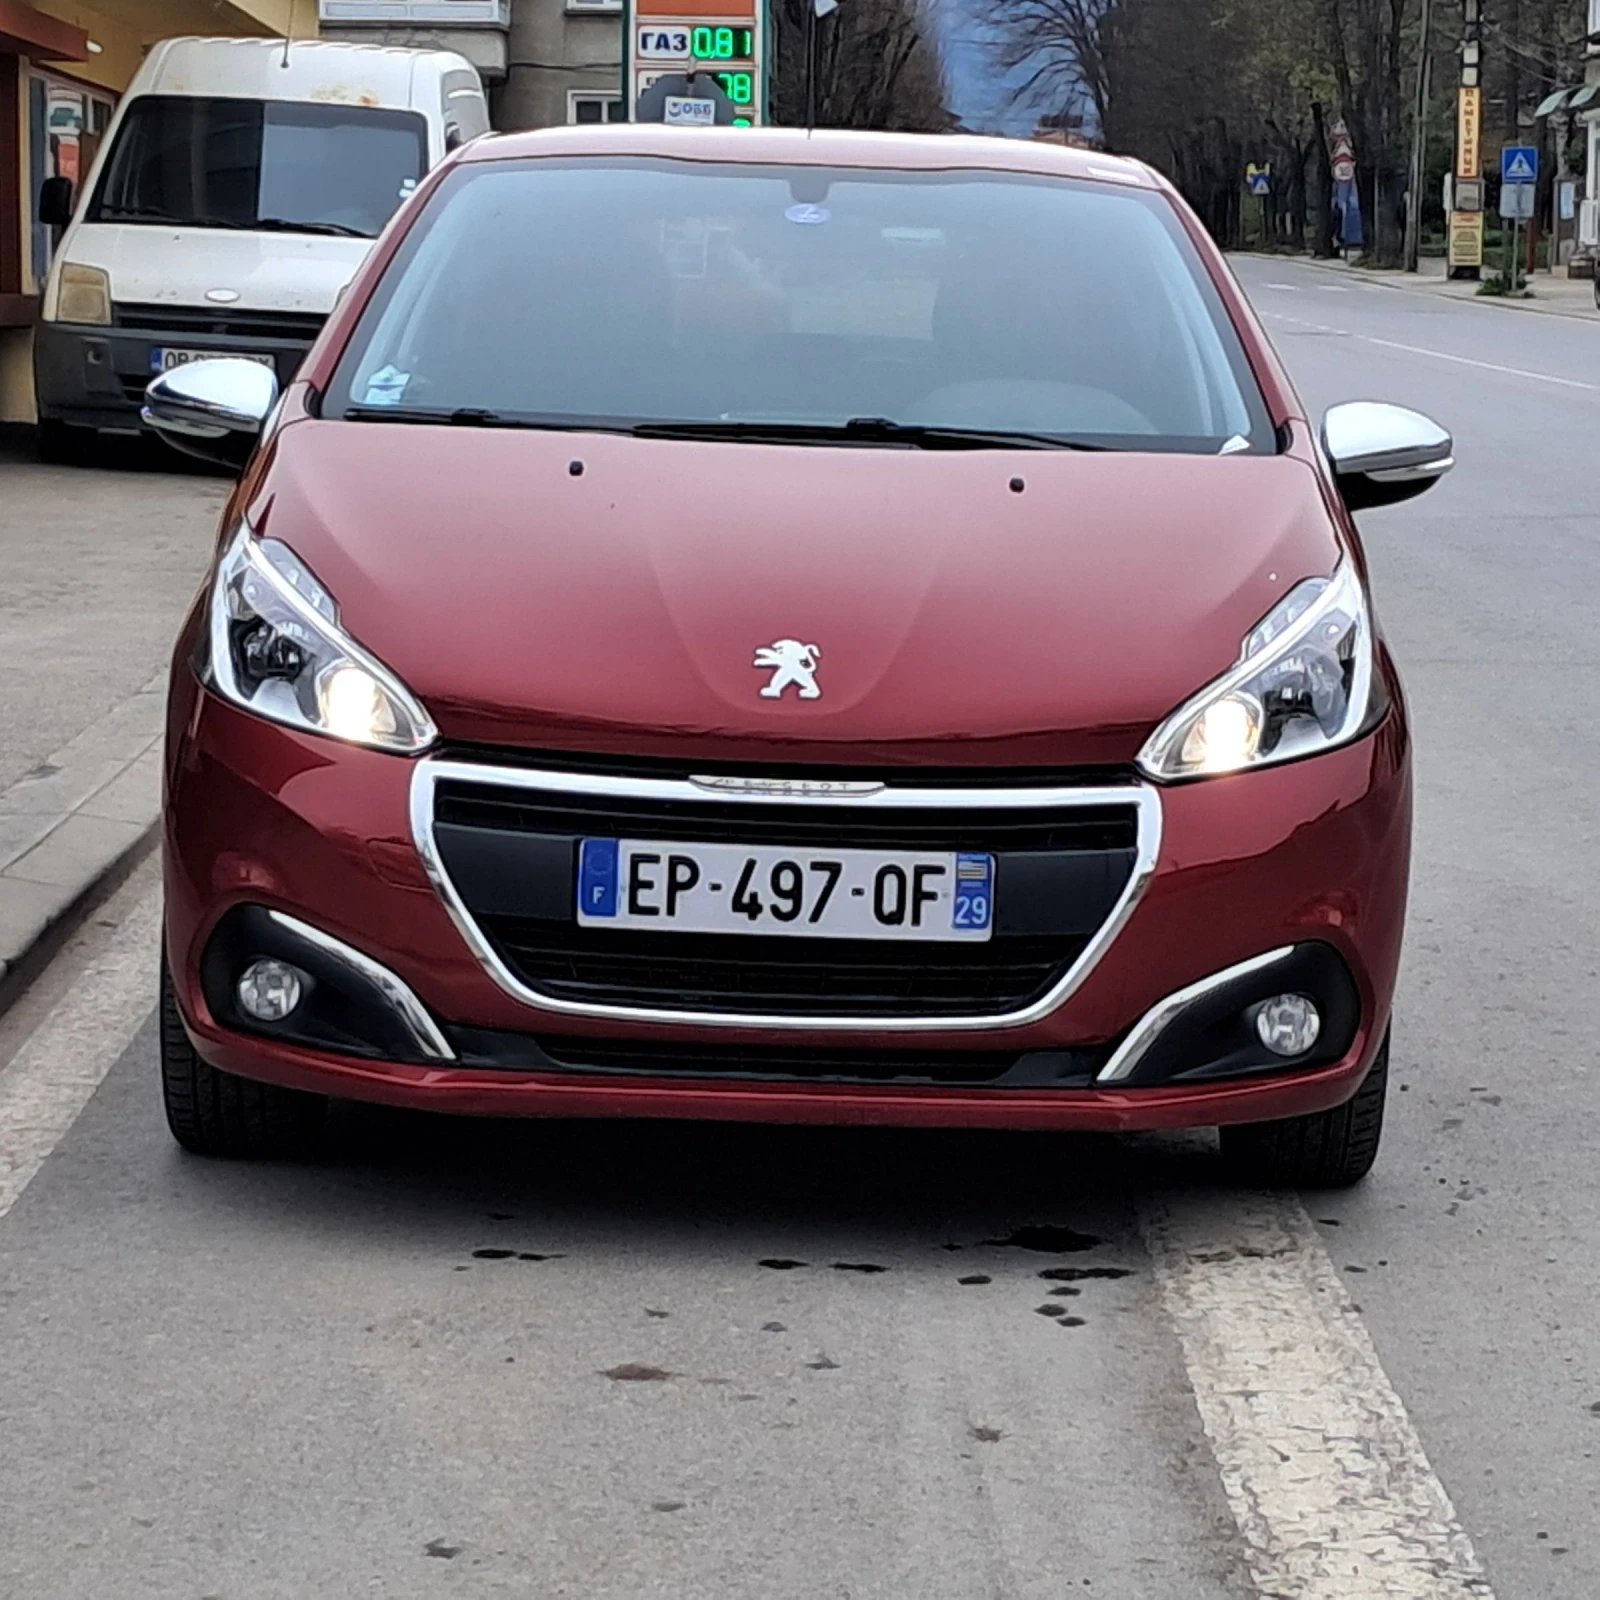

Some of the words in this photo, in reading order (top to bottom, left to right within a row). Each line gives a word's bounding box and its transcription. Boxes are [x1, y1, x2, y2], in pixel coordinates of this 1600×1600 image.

[640, 32, 688, 52] ГАЗ
[593, 887, 605, 905] F
[955, 896, 986, 924] 29
